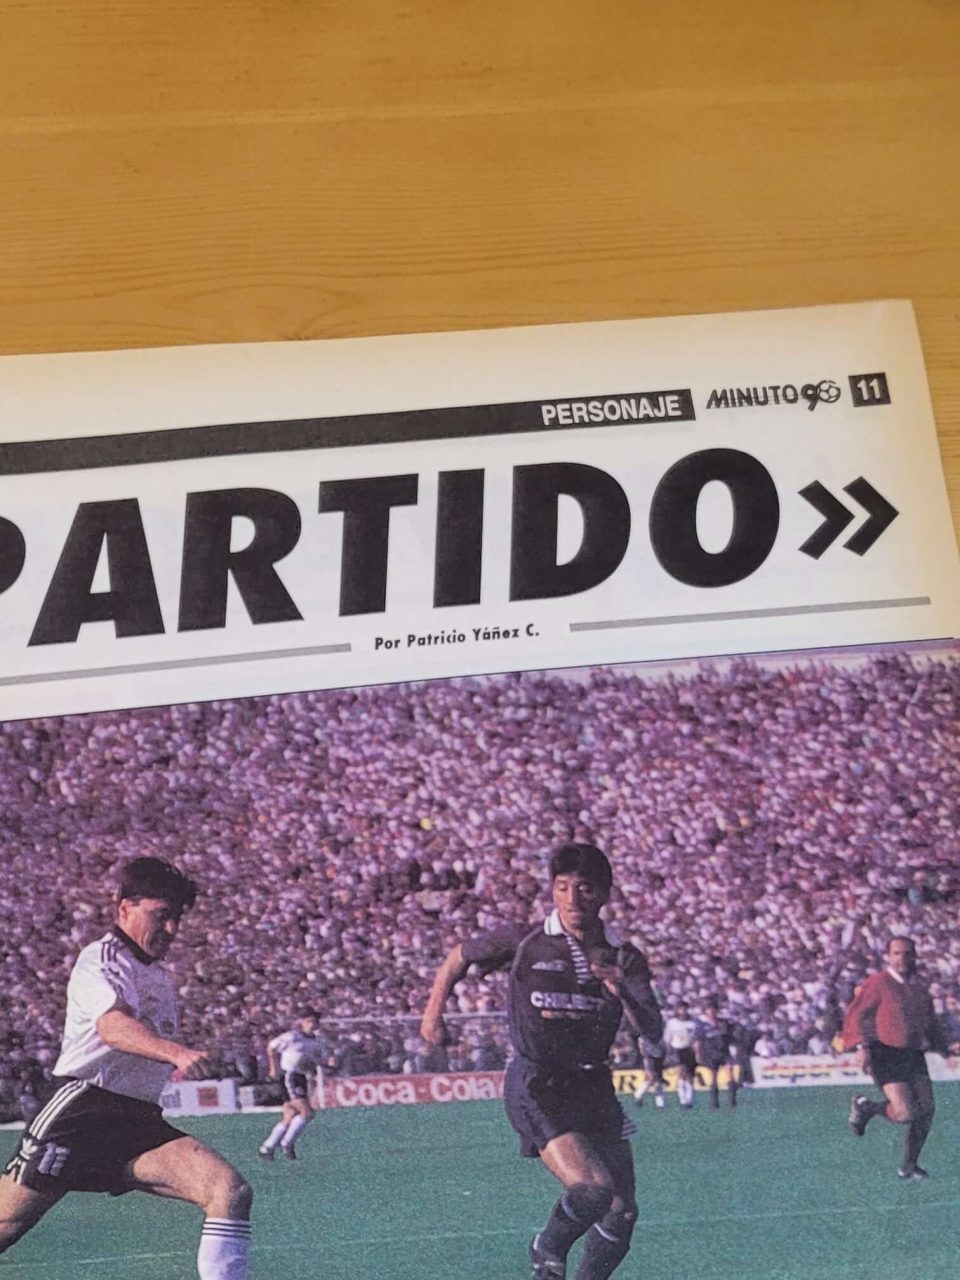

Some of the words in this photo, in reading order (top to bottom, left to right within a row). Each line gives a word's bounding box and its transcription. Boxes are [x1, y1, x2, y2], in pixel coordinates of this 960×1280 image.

[855, 378, 883, 401] 11
[540, 395, 682, 426] PERSONAJE
[374, 636, 401, 651] Por
[407, 628, 466, 648] Patricio
[472, 626, 520, 642] Yáñez
[525, 622, 540, 637] C.
